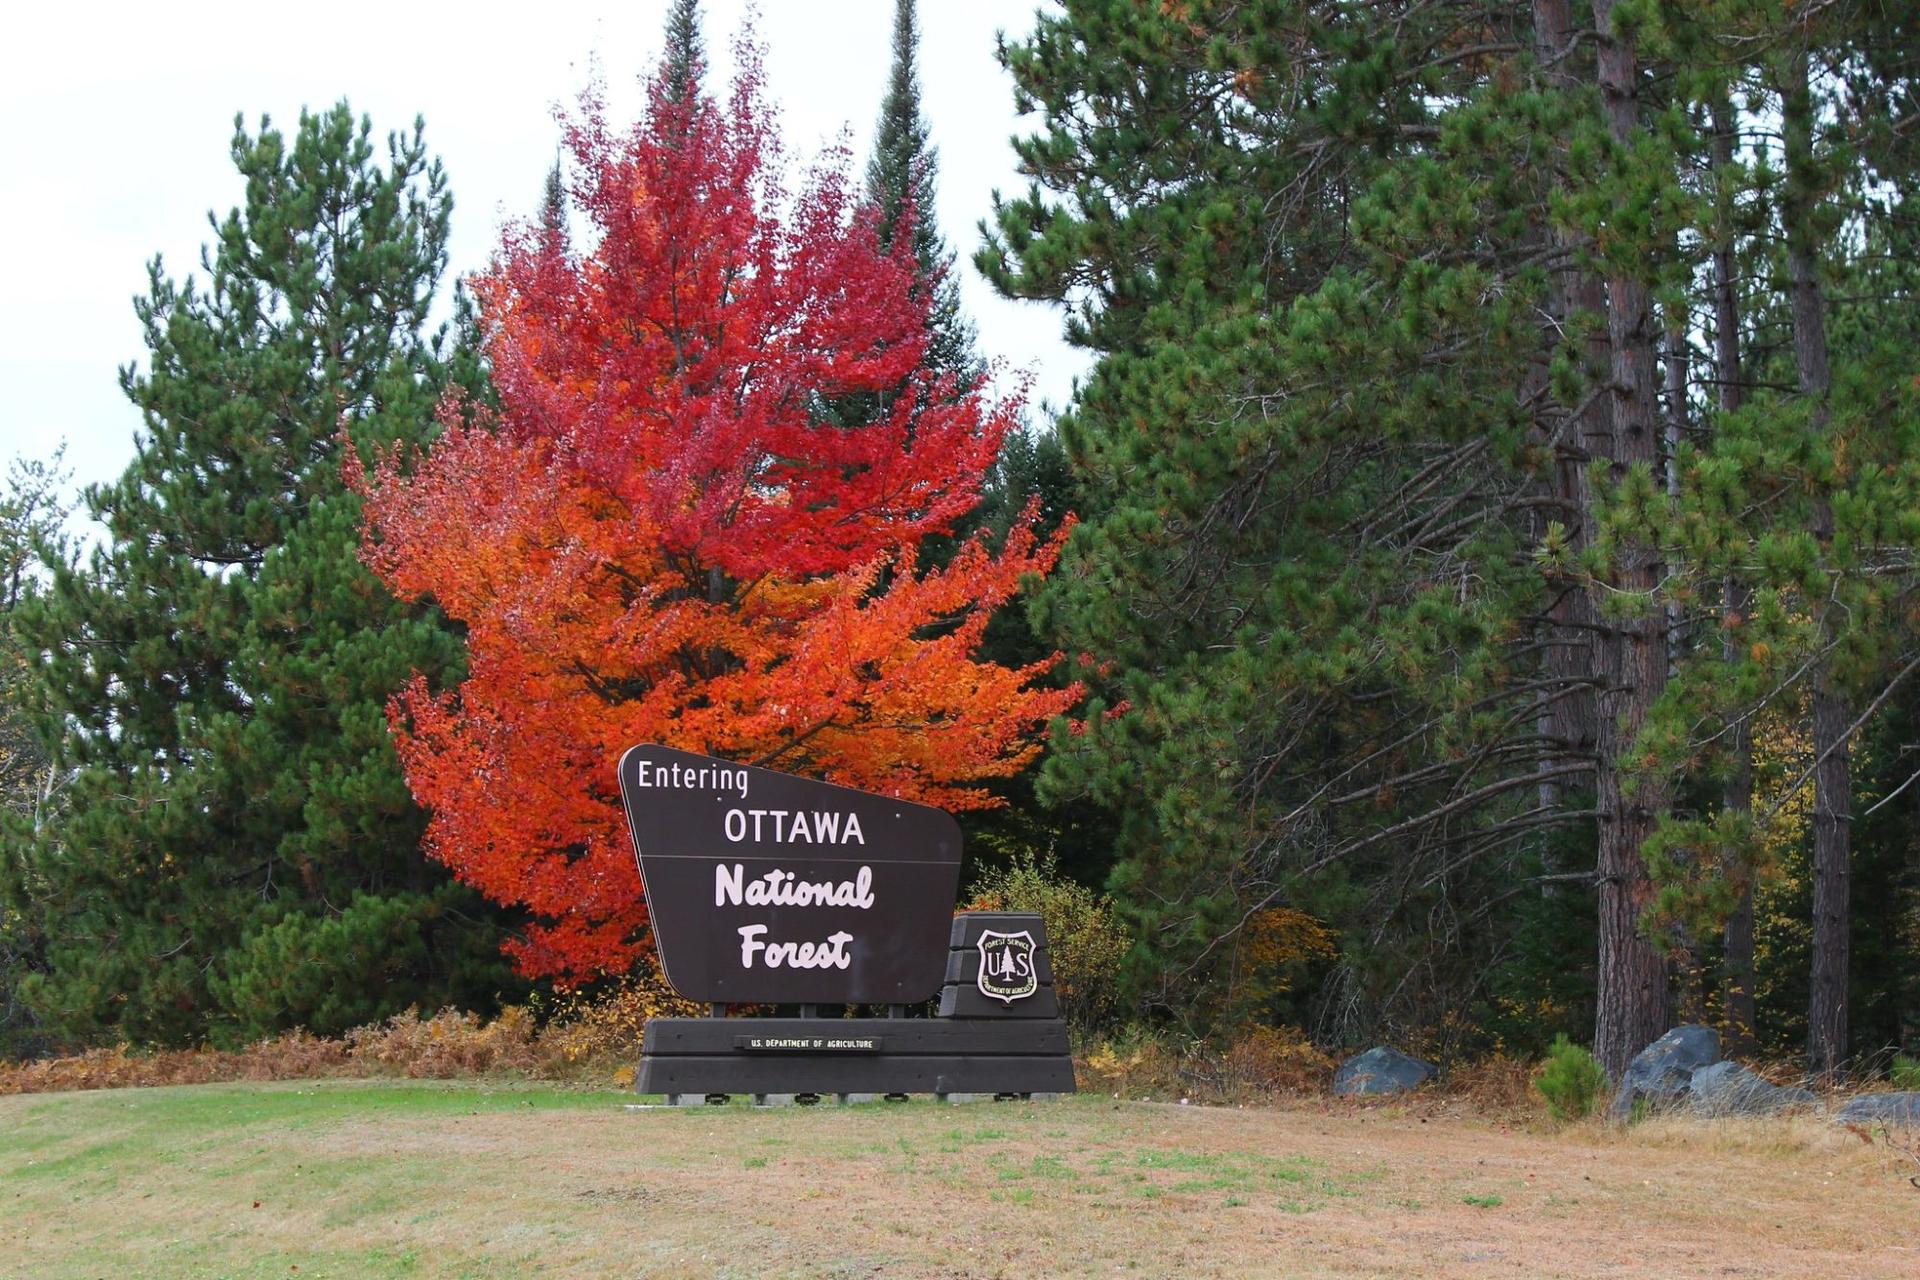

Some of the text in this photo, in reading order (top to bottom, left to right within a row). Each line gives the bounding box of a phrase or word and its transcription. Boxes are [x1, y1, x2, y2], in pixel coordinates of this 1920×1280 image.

[638, 760, 749, 799] Entering
[724, 808, 865, 845] OTTAWA
[714, 863, 876, 910] National
[737, 923, 854, 970] Forest
[985, 939, 1029, 951] FOREST SERVICE
[987, 952, 1029, 976] U S
[765, 1039, 809, 1048] DEPARTMENT
[813, 1039, 822, 1048] OF
[827, 1039, 873, 1049] AGRICULTURE
